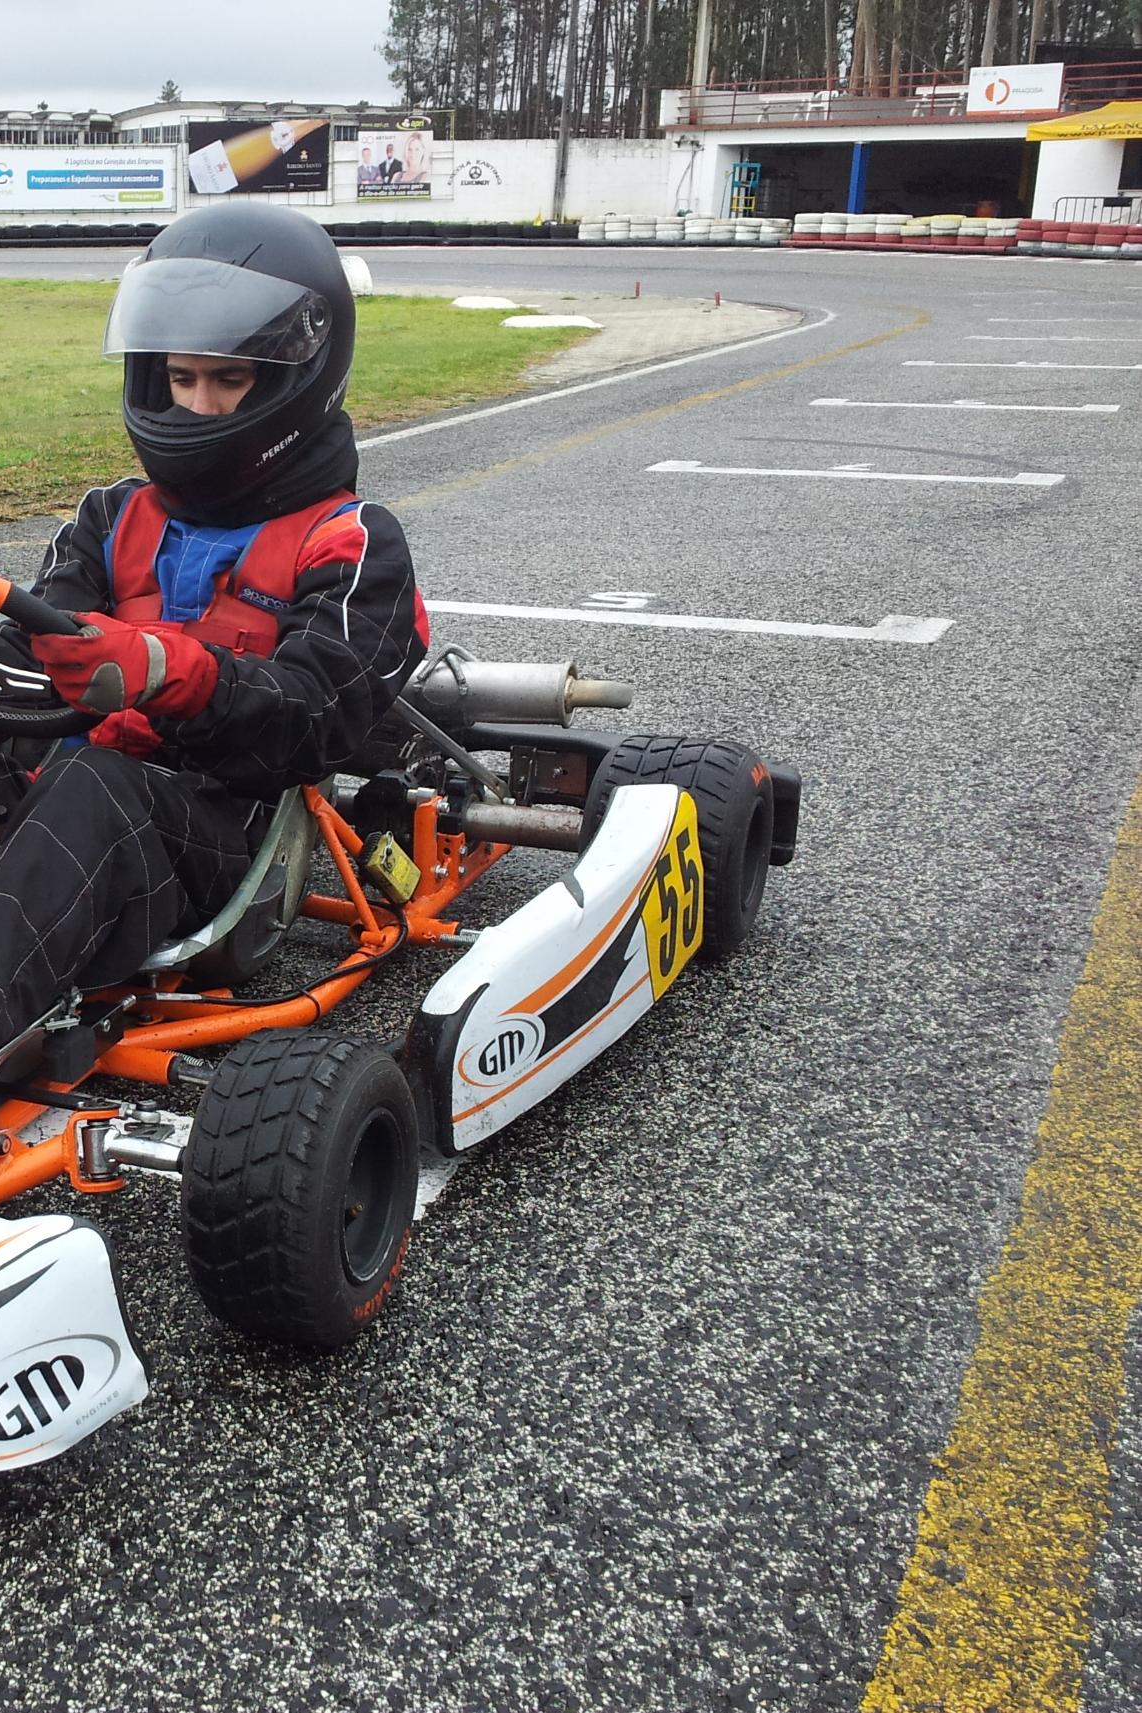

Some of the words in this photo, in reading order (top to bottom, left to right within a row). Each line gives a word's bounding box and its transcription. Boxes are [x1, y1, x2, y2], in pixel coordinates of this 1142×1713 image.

[262, 430, 300, 462] PEREIRA
[656, 827, 702, 978] 55
[478, 1029, 525, 1076] GM
[75, 1390, 120, 1427] ENGINES
